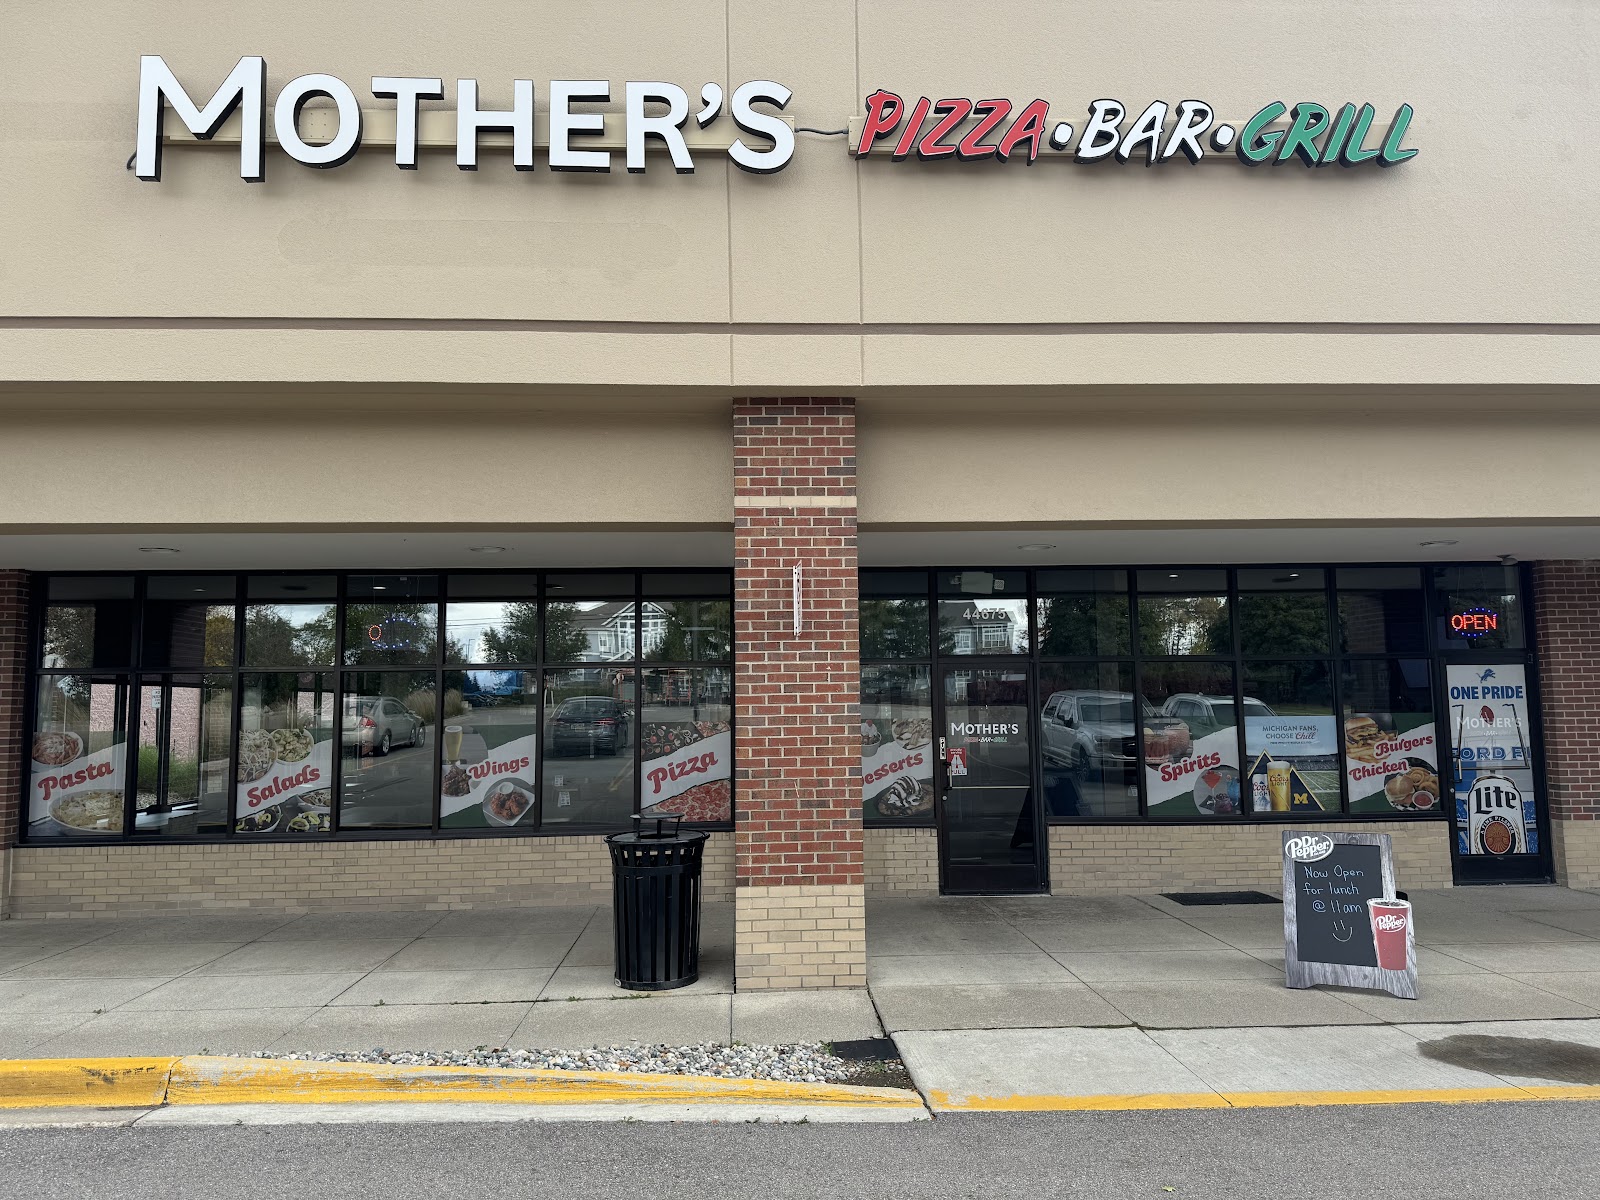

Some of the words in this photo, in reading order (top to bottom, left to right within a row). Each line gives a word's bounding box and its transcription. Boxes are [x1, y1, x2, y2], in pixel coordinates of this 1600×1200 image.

[135, 54, 796, 181] MOTHER'S
[855, 89, 1050, 166] PIZZA
[1075, 99, 1214, 167] BAR
[1237, 100, 1420, 167] GRILL
[963, 607, 1006, 620] 44675
[1451, 614, 1497, 630] OPEN
[1450, 686, 1479, 700] ONE
[1482, 685, 1524, 699] PRIDE
[951, 722, 1019, 736] MOTHER'S
[1294, 732, 1317, 740] Chill
[1375, 735, 1434, 757] Burgers
[468, 756, 530, 780] Wings
[646, 751, 719, 795] Pizza
[862, 752, 924, 786] esserts
[1160, 751, 1221, 782] Spirits
[1348, 760, 1408, 781] Chicken
[37, 761, 115, 801] Pasta
[247, 764, 321, 808] Salads
[1474, 786, 1518, 814] Lite
[1286, 838, 1330, 859] Pepper
[1301, 835, 1319, 848] Dr
[1303, 865, 1329, 878] Now
[1333, 864, 1364, 882] Open
[1302, 882, 1324, 896] for
[1328, 882, 1360, 895] lunch
[1330, 899, 1363, 913] 11am
[1377, 916, 1404, 930] Pepper
[1385, 914, 1397, 923] Dr
